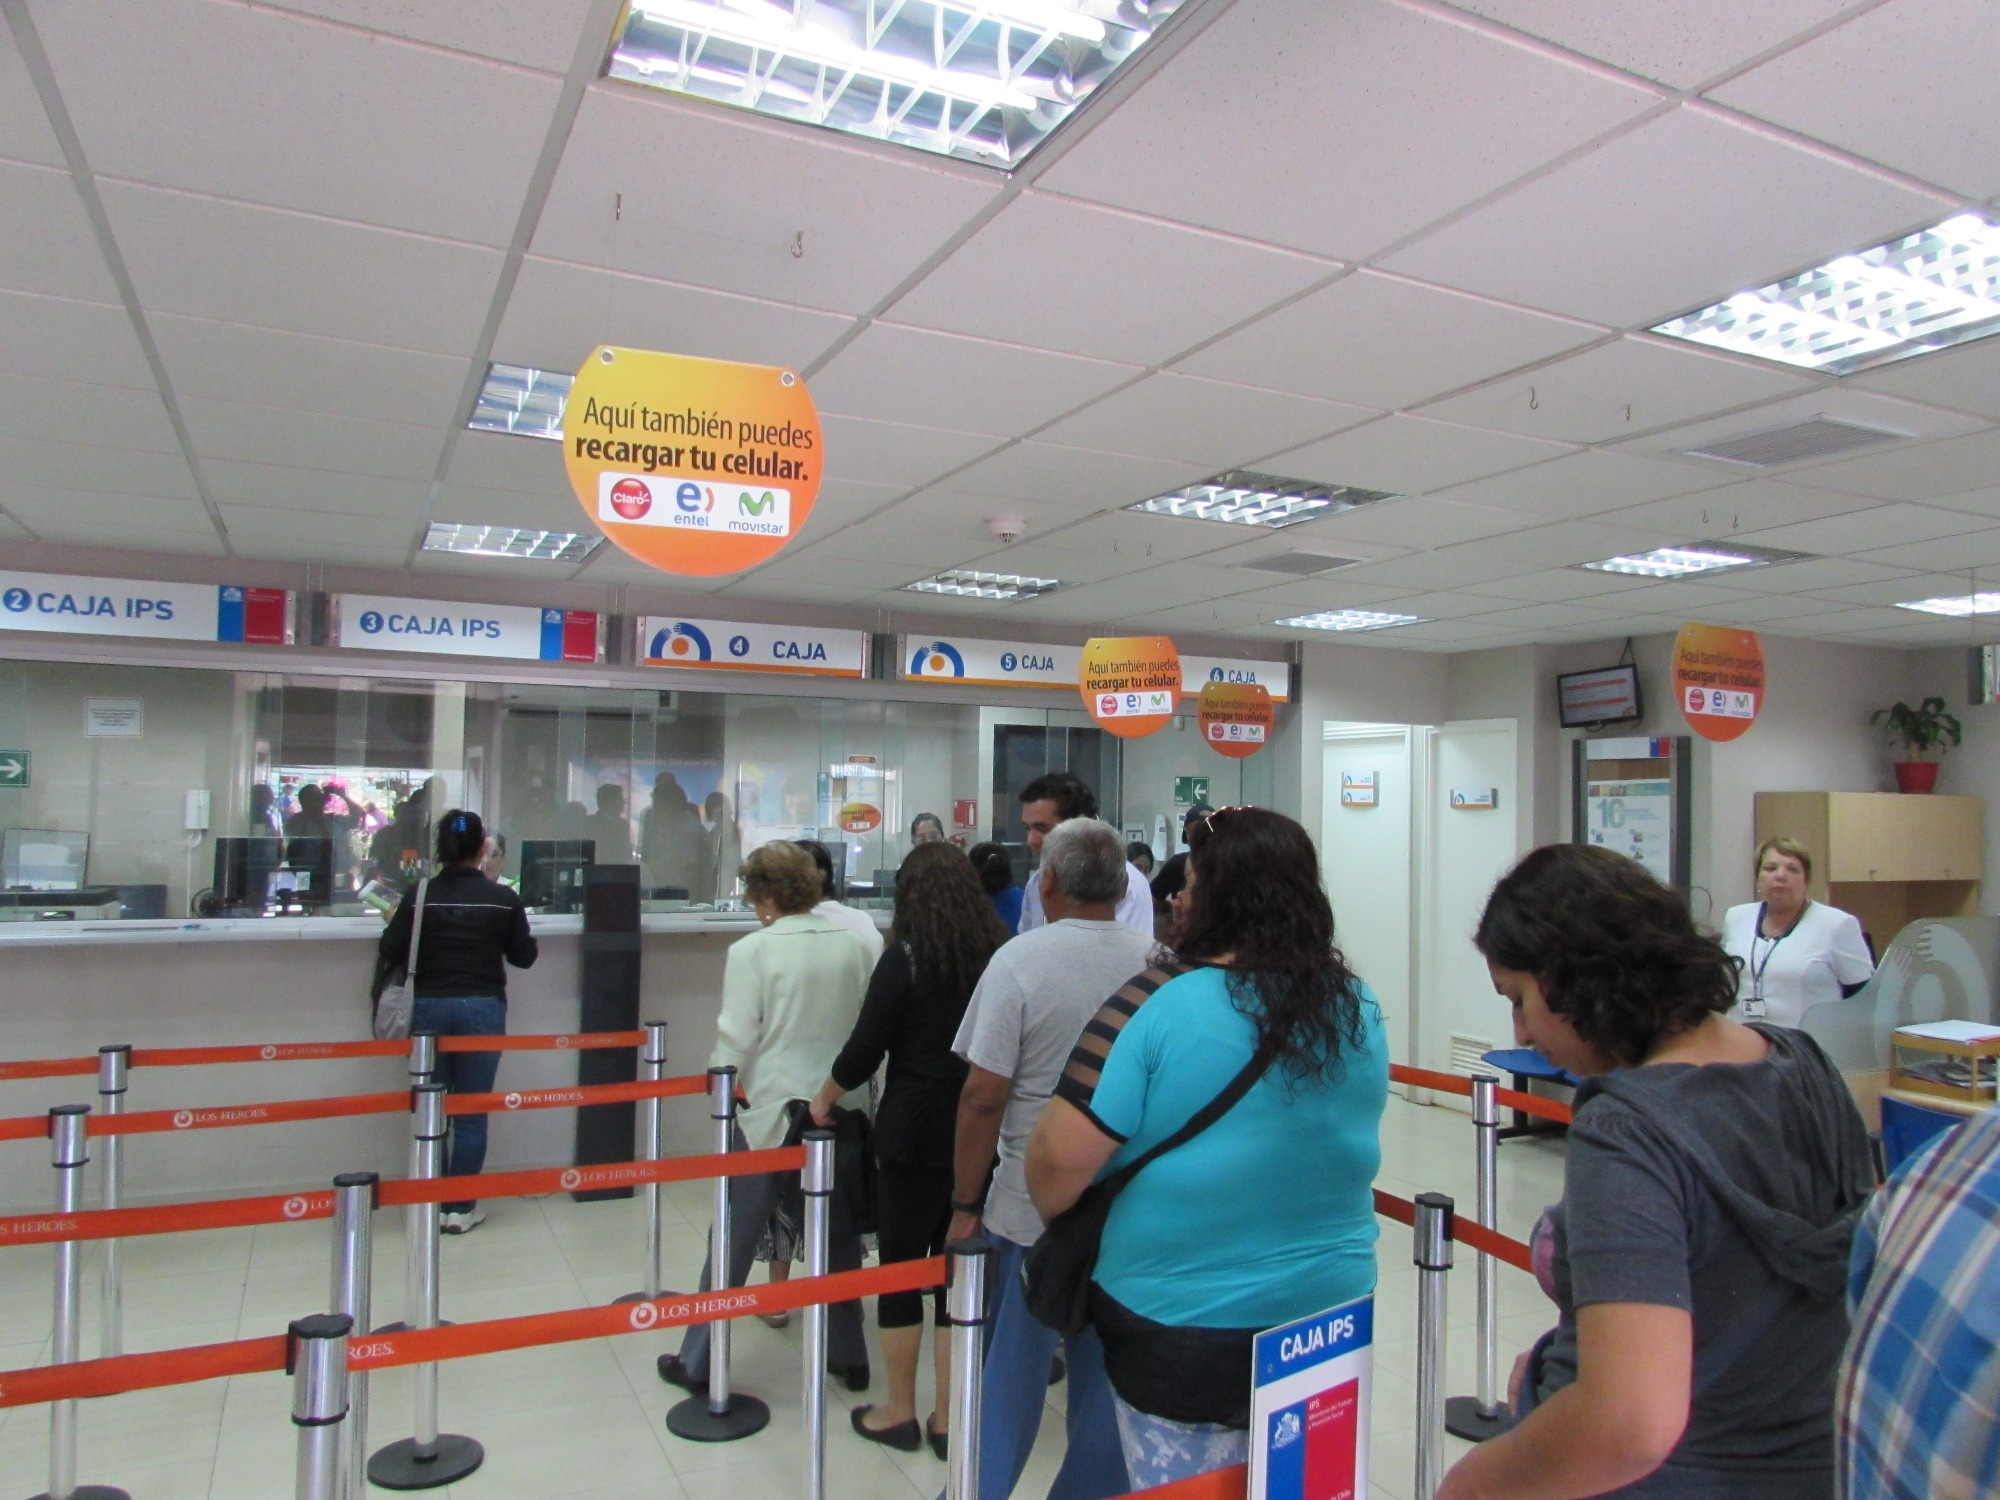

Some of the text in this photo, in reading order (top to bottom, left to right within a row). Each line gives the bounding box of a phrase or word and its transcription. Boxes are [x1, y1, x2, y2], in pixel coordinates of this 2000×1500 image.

[583, 396, 813, 449] Aquí también puedes
[576, 436, 809, 481] recargar tu celular.
[613, 491, 645, 505] Claro
[674, 514, 709, 527] entel
[728, 520, 783, 534] movistar
[11, 589, 174, 621] 2 CAJA IPS
[365, 613, 501, 638] 3 CAJA IPS
[772, 640, 827, 661] CAJA
[1021, 654, 1054, 671] CAJA
[1088, 658, 1179, 678] Aquí también puedes
[1086, 674, 1179, 692] recargar tu celular.
[1228, 669, 1256, 684] CAJA
[1202, 711, 1234, 723] recargar
[1235, 712, 1243, 721] tu
[523, 1094, 542, 1104] LOS
[195, 1112, 218, 1122] LOS
[583, 1170, 606, 1182] LOS
[660, 1303, 690, 1320] LOS
[1280, 1313, 1355, 1363] CAJA IPS
[1309, 1398, 1320, 1410] IPS
